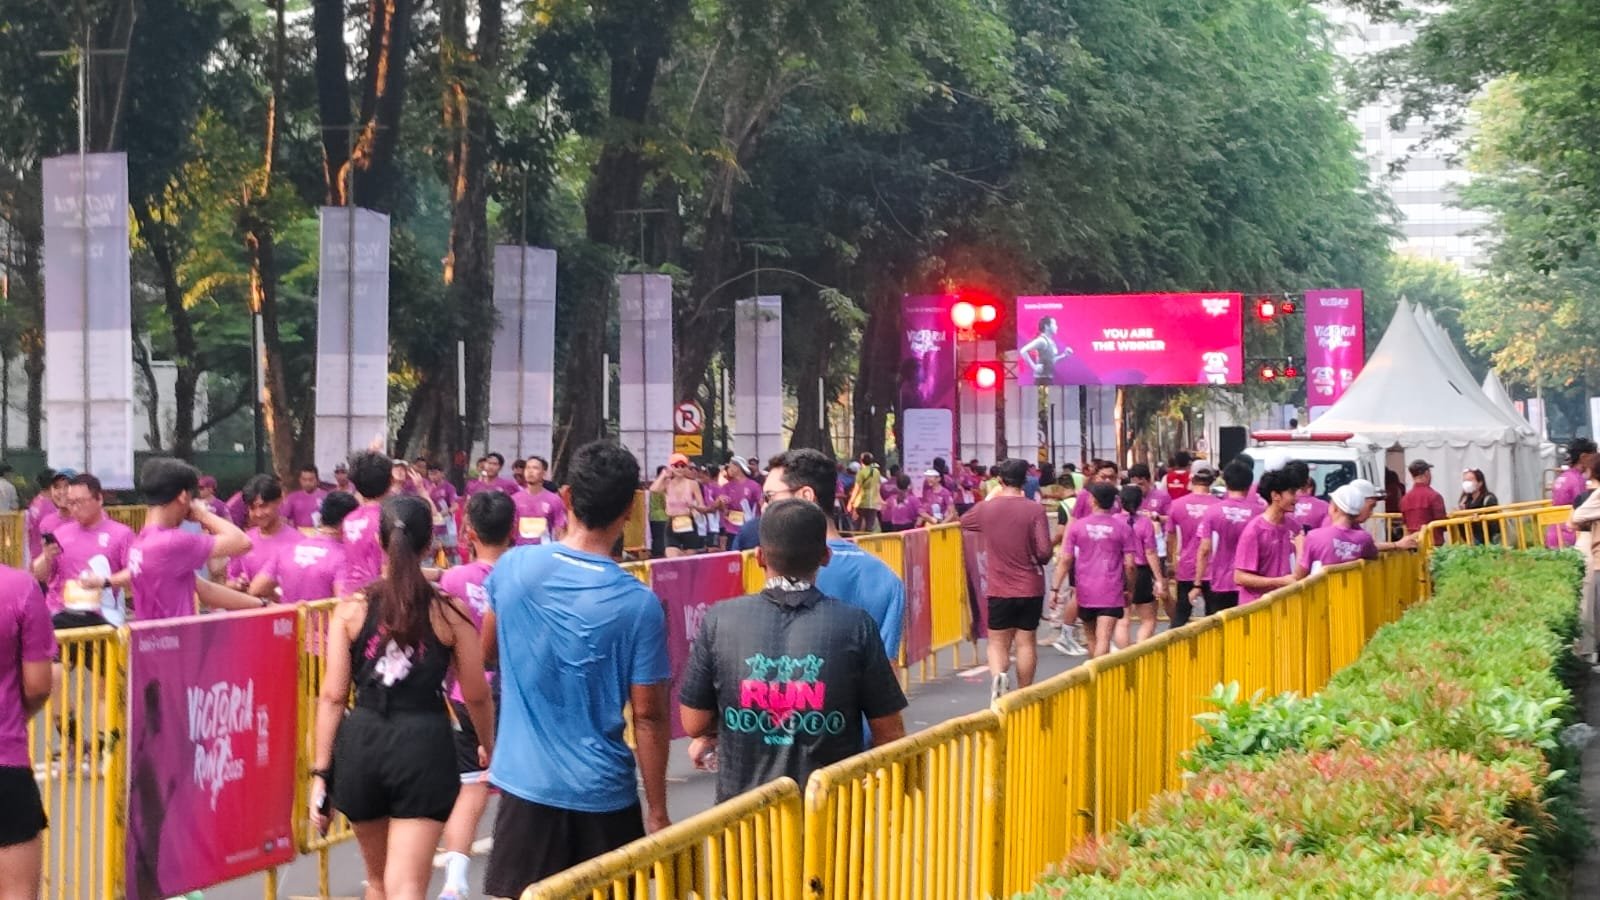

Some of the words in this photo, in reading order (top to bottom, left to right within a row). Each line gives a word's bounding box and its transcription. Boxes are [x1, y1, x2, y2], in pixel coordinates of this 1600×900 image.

[1103, 328, 1129, 339] YOU
[1130, 328, 1154, 339] ARE
[1092, 341, 1116, 352] THE
[1117, 341, 1166, 352] WINNER
[739, 679, 827, 711] RUN
[187, 678, 255, 742] VICTORIA
